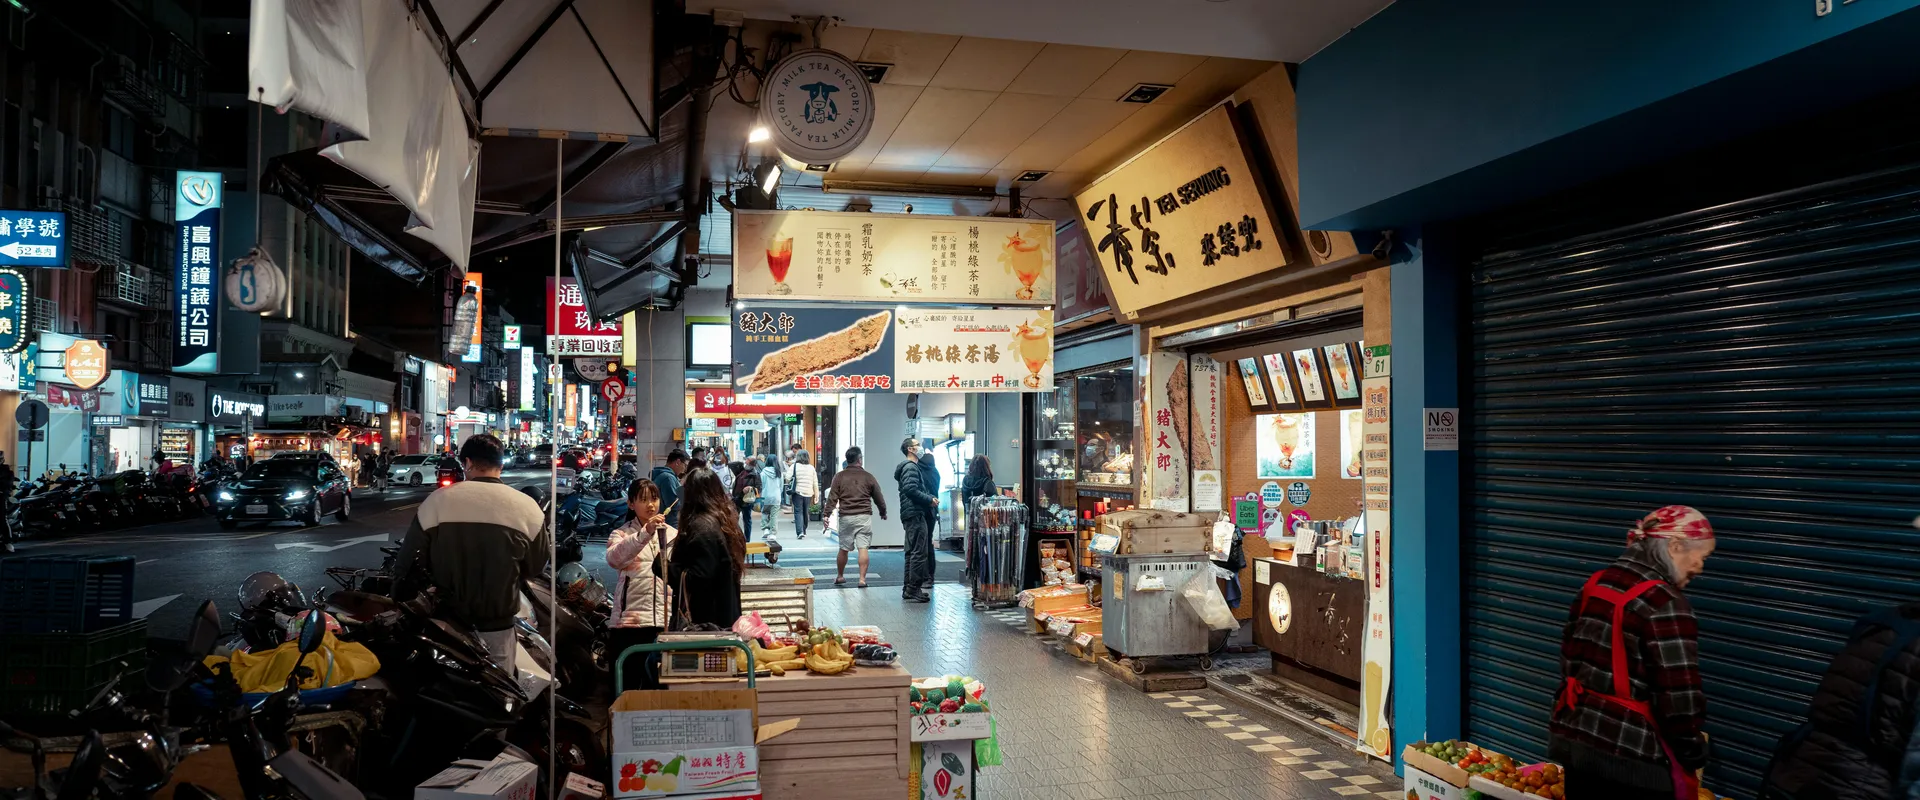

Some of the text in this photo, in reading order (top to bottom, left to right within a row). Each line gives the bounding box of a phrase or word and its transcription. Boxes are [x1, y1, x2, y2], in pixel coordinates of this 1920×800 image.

[782, 62, 860, 113] MILK TEA FACTORY
[777, 92, 855, 142] MILK TEA FACTORY
[1153, 165, 1231, 216] TEA SERVING
[862, 223, 873, 276] 霜乳奶茶
[968, 226, 979, 296] 楊桃綠茶湯
[190, 225, 211, 346] 富興鐘錶公司
[740, 312, 795, 333] 豬大郎
[905, 344, 1001, 364] 楊桃綠茶湯
[1375, 359, 1385, 374] 61
[223, 400, 235, 415] THE
[794, 376, 891, 389] 全台最大最好吃
[1156, 408, 1171, 471] 豬大郎
